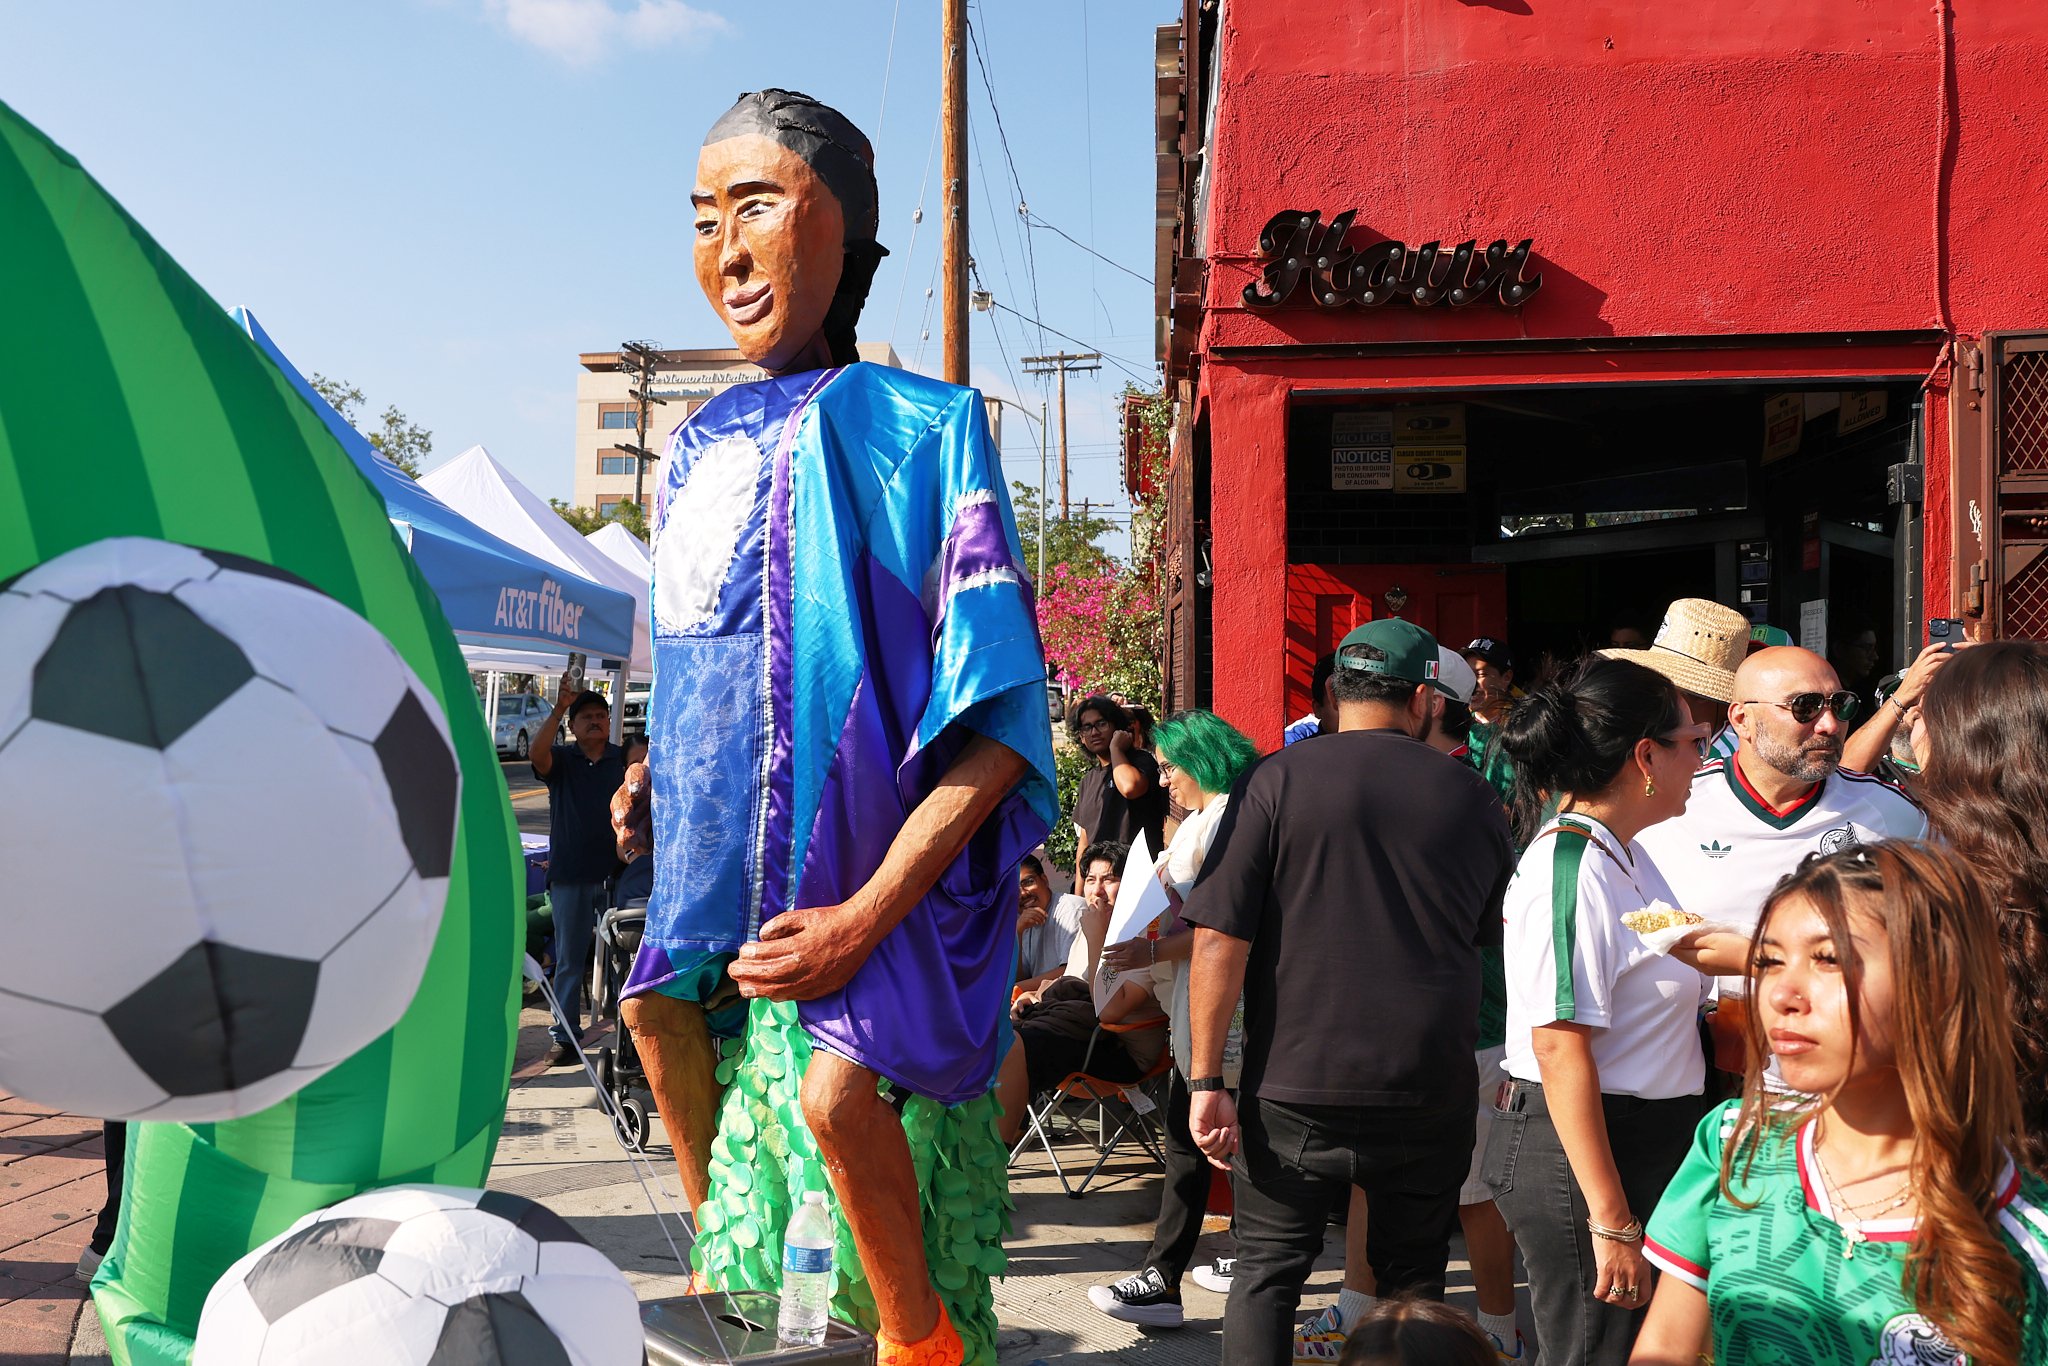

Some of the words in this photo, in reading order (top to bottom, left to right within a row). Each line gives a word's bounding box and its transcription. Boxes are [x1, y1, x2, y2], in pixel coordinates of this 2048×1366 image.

[663, 372, 716, 385] Memorial
[716, 371, 762, 384] Medical
[1858, 396, 1868, 412] 21
[1844, 405, 1881, 427] ALLOWED
[1335, 450, 1390, 463] NOTICE
[1362, 464, 1391, 472] REQUIRED
[494, 586, 538, 630] AT&T
[538, 579, 585, 640] fiber
